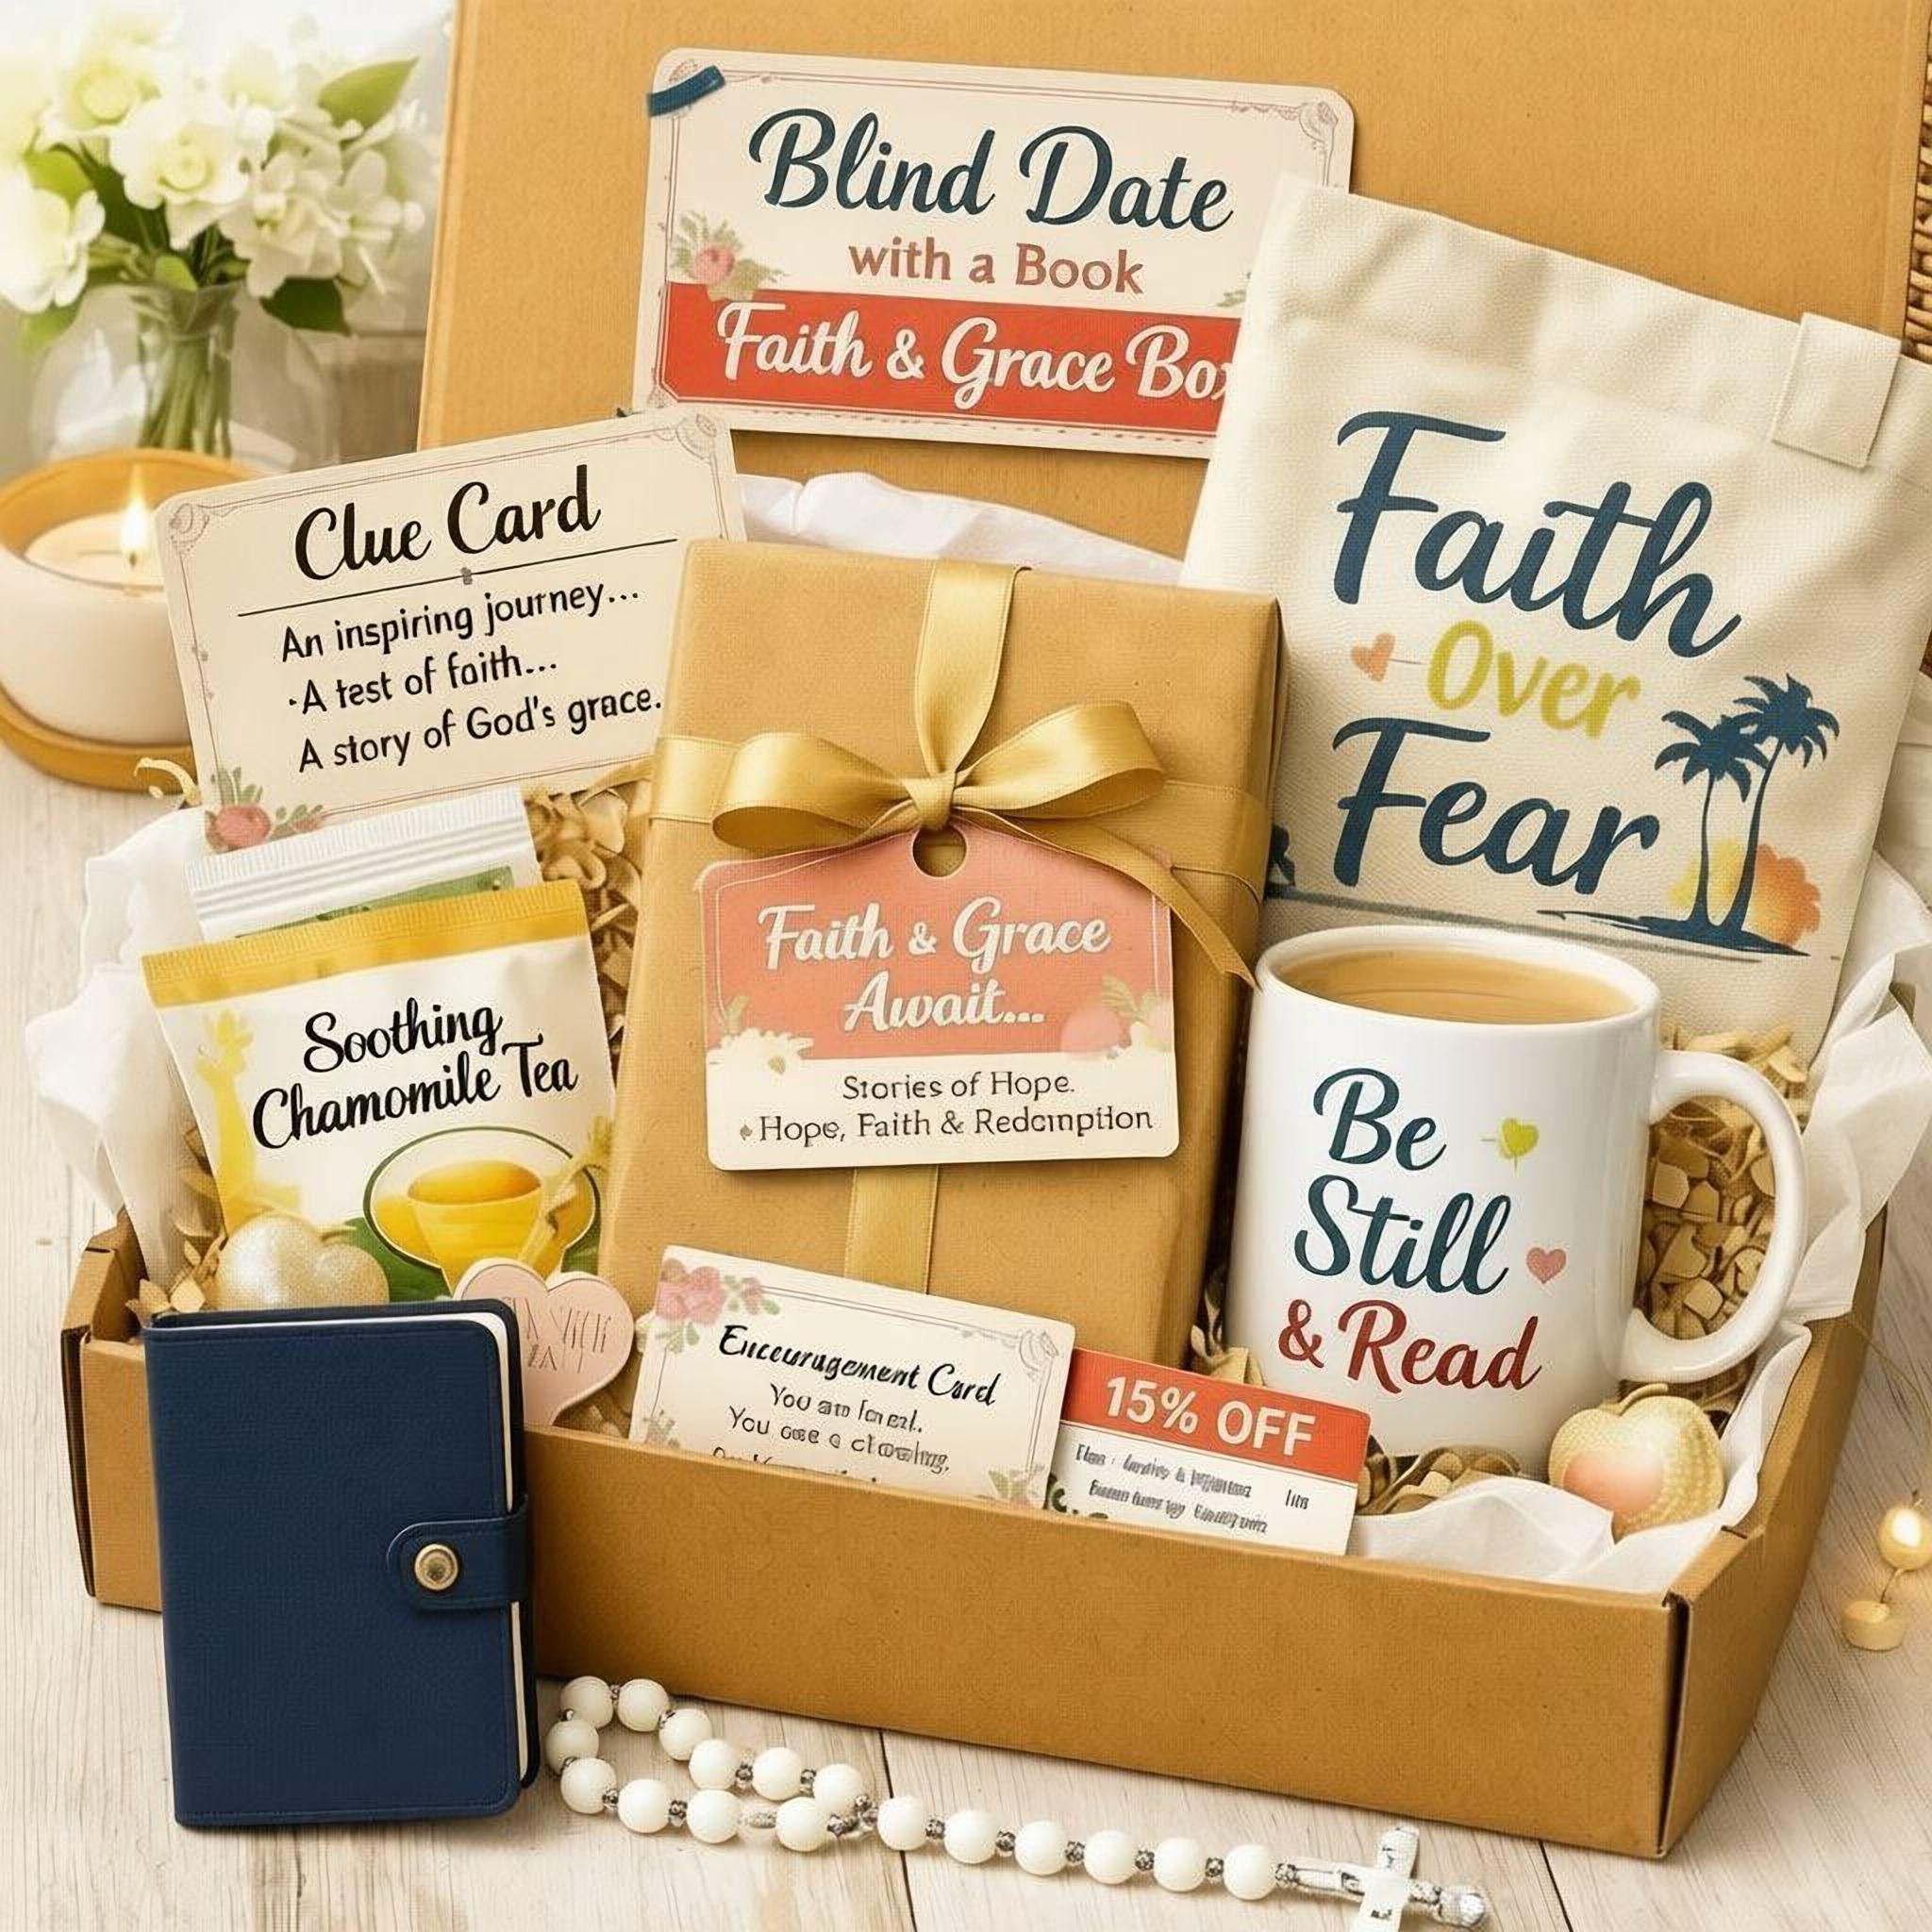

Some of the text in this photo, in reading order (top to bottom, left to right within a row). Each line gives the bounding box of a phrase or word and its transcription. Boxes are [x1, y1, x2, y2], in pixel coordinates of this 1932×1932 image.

[748, 108, 1234, 232] Blind Date
[849, 237, 1144, 295] with a Book
[716, 301, 874, 380] Faith
[887, 329, 925, 380] &
[943, 317, 1115, 409] Grace
[294, 464, 602, 581] Clue Card
[1333, 411, 1742, 658] Faith
[282, 582, 640, 662] An inspiring journey...
[336, 671, 392, 709] test
[405, 657, 437, 696] of
[448, 645, 558, 690] faith...
[1426, 620, 1641, 739] Over
[299, 688, 663, 774] A story of God's grace.
[1332, 717, 1660, 895] Fear
[758, 896, 1111, 974] Faith & Grace
[303, 997, 504, 1074] Soothing
[844, 971, 1045, 1032] Await...
[253, 1033, 579, 1150] Chamomile Tea
[759, 1114, 846, 1148] Hope,
[857, 1110, 930, 1139] Faith
[941, 1109, 964, 1135] &
[842, 1074, 942, 1101] Stories
[951, 1072, 982, 1097] of
[1313, 1067, 1448, 1171] Be
[1294, 1174, 1512, 1295] Still
[1278, 1298, 1543, 1394] & Read
[728, 1406, 770, 1435] You
[770, 1383, 811, 1410] You
[1106, 1375, 1316, 1457] 15% OFF
